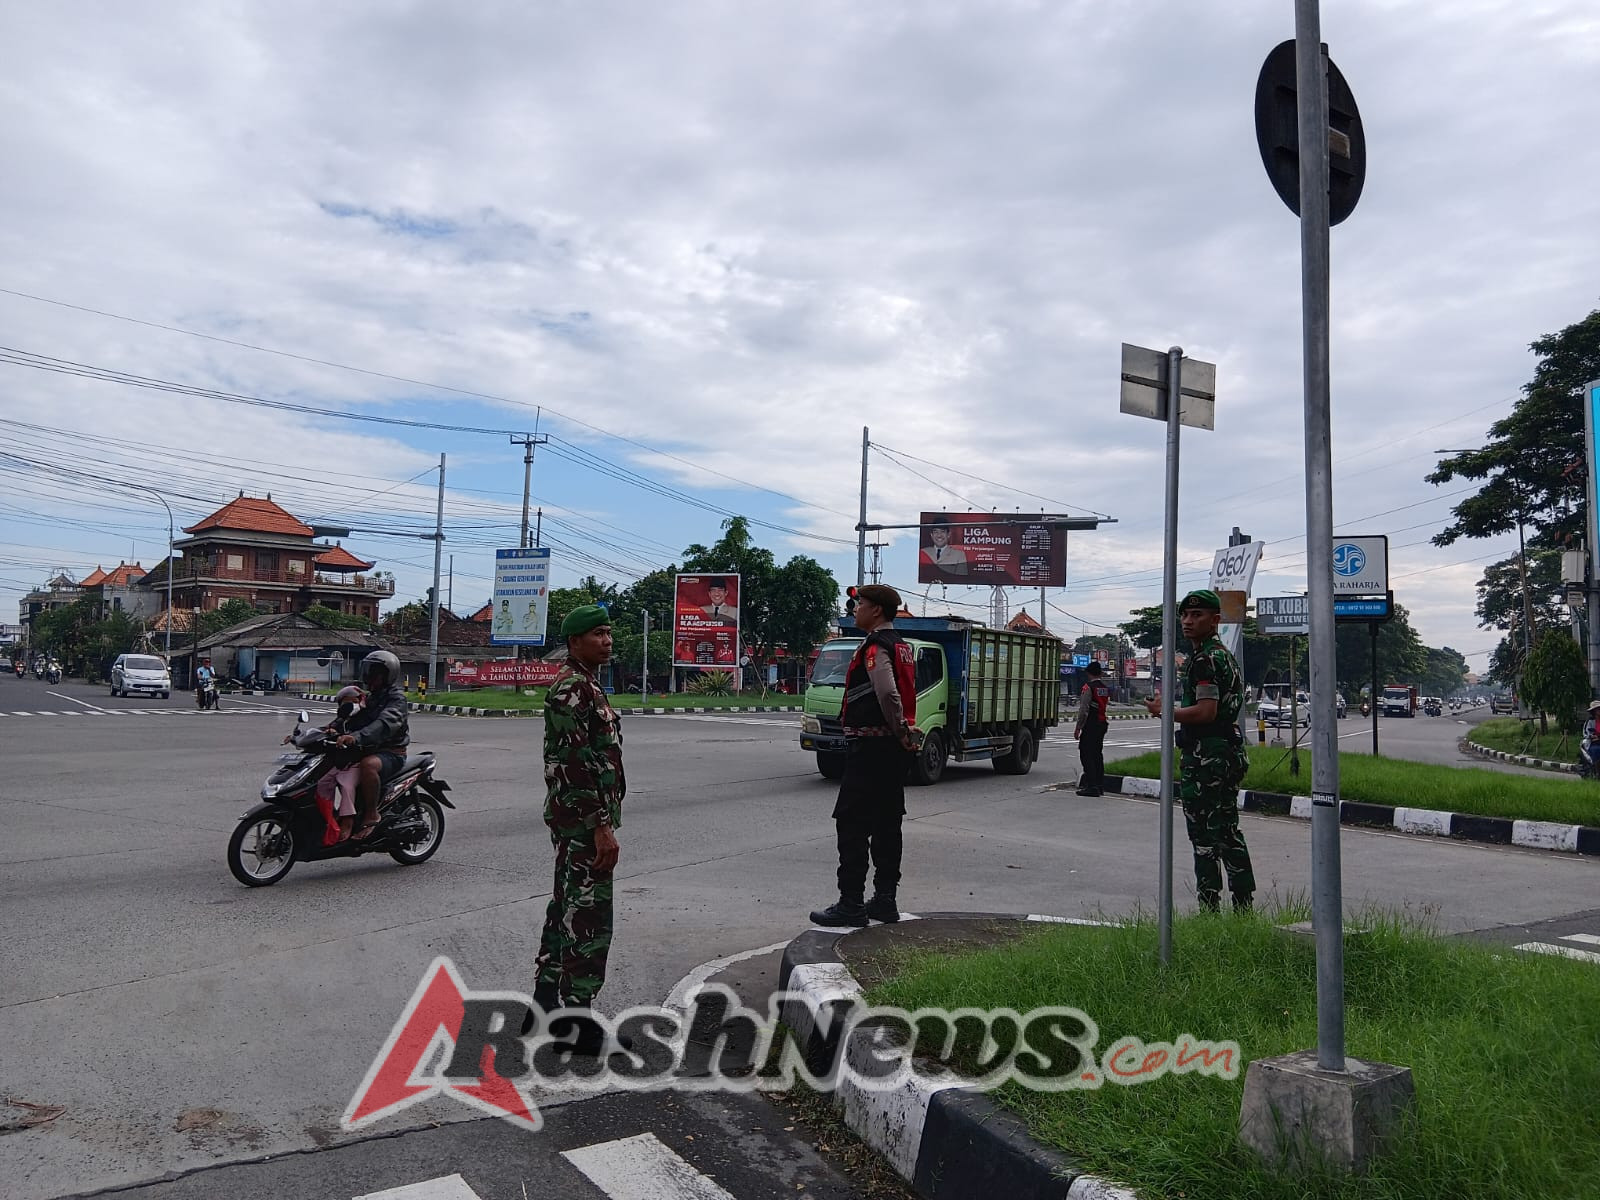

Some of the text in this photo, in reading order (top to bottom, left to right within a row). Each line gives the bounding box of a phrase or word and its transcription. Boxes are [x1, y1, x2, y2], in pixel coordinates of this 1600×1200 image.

[964, 528, 989, 536] LIGA
[963, 537, 1012, 545] KAMPUNG
[1258, 599, 1277, 615] BR.
[490, 665, 549, 673] SELAMAT NATAL
[489, 673, 515, 681] TAHUN
